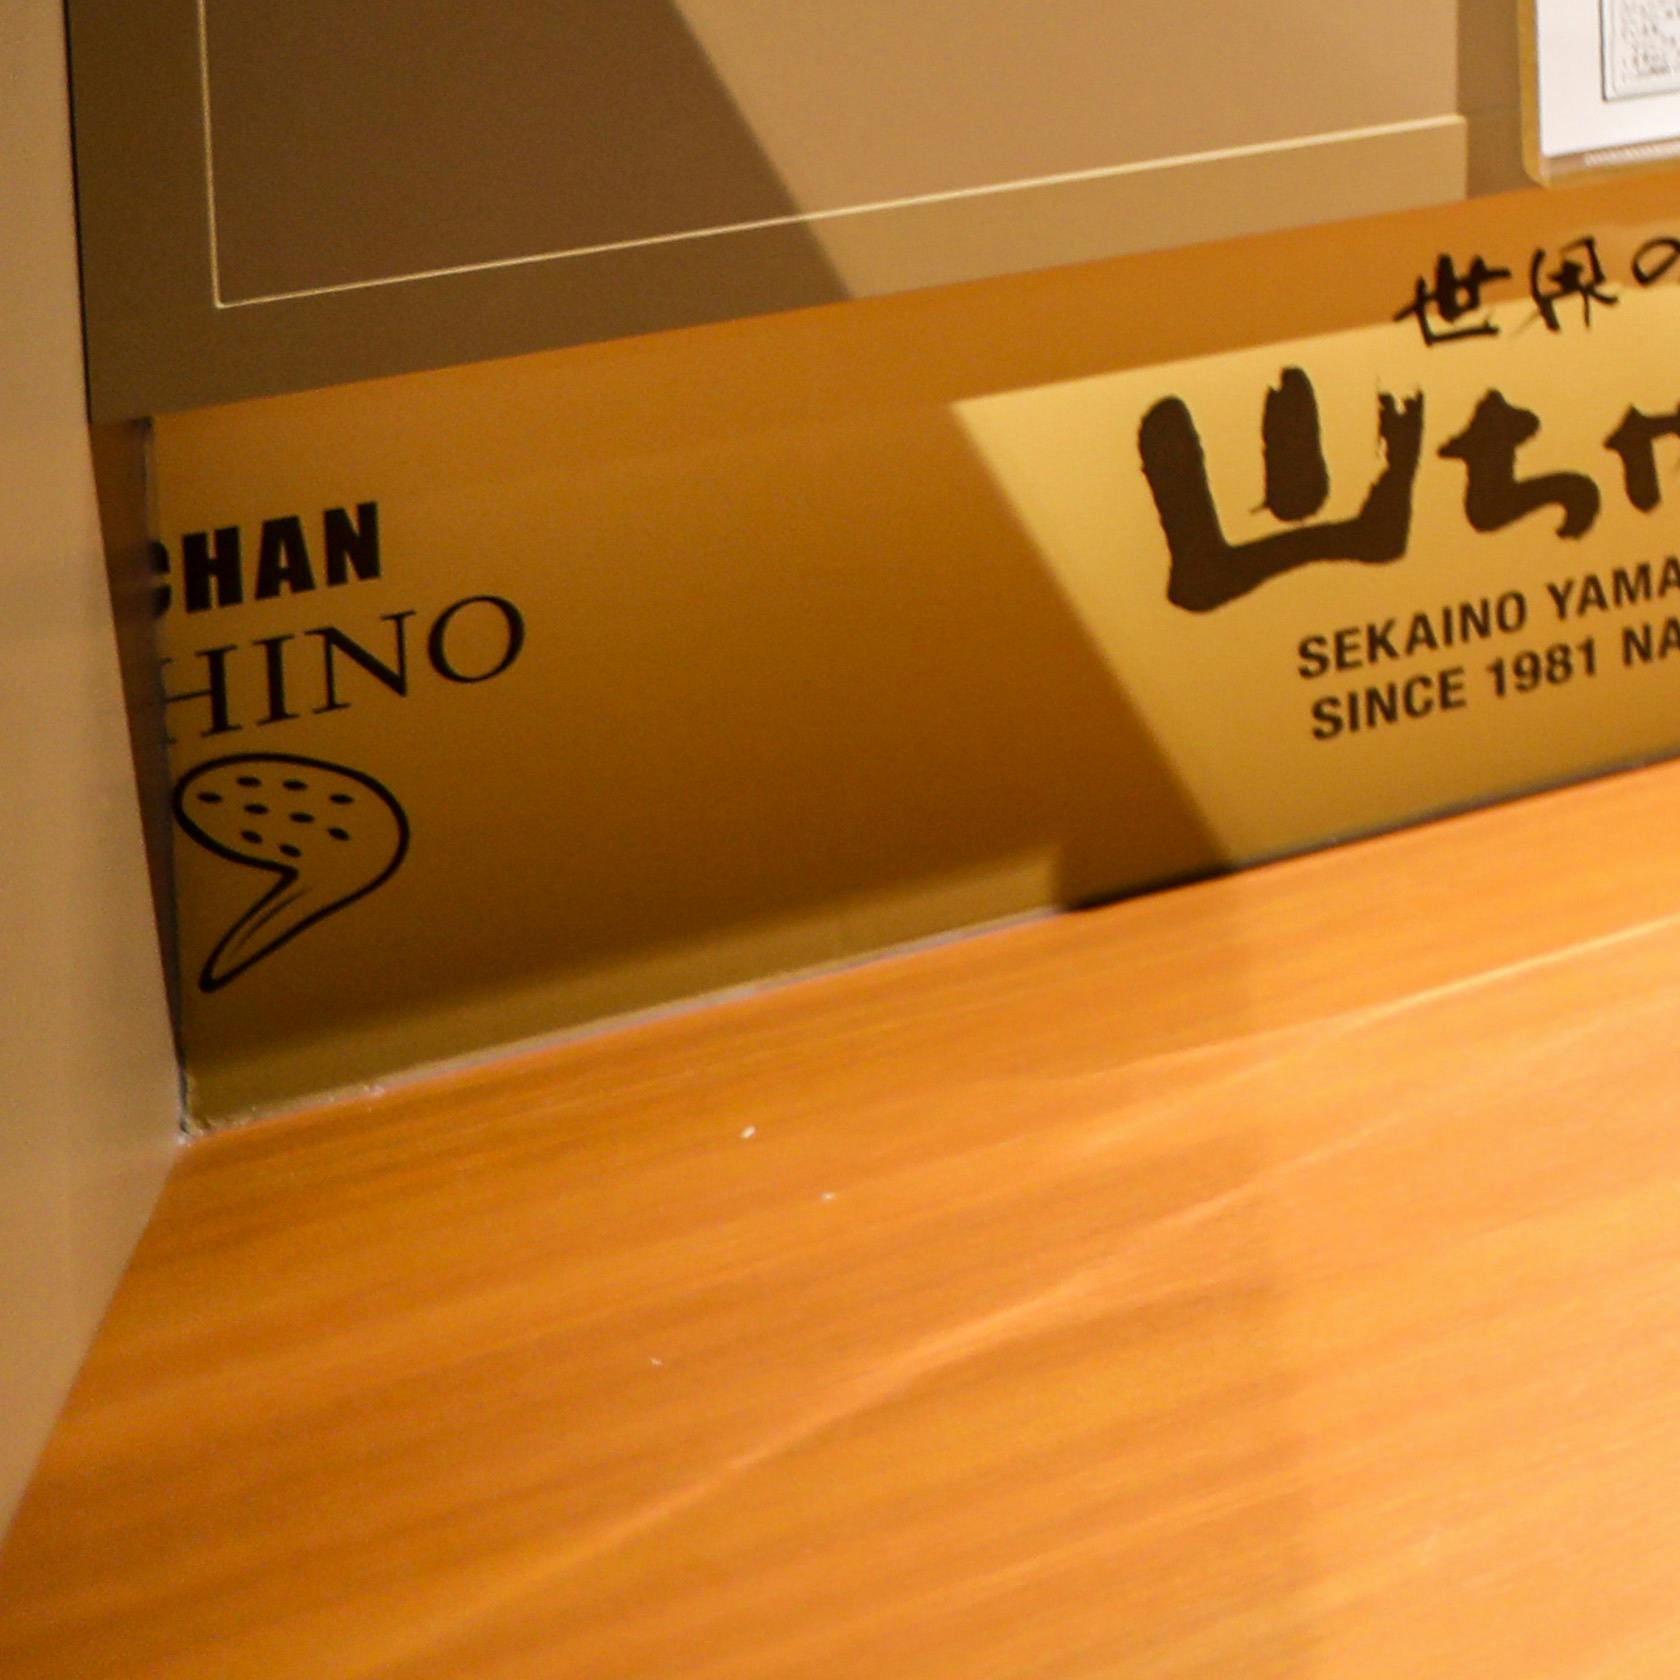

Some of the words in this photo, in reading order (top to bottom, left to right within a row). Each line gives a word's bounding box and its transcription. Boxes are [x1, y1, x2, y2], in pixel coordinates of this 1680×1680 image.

[1297, 589, 1529, 681] SEKAINO
[1312, 666, 1467, 742] SINCE
[1486, 635, 1598, 699] 1981
